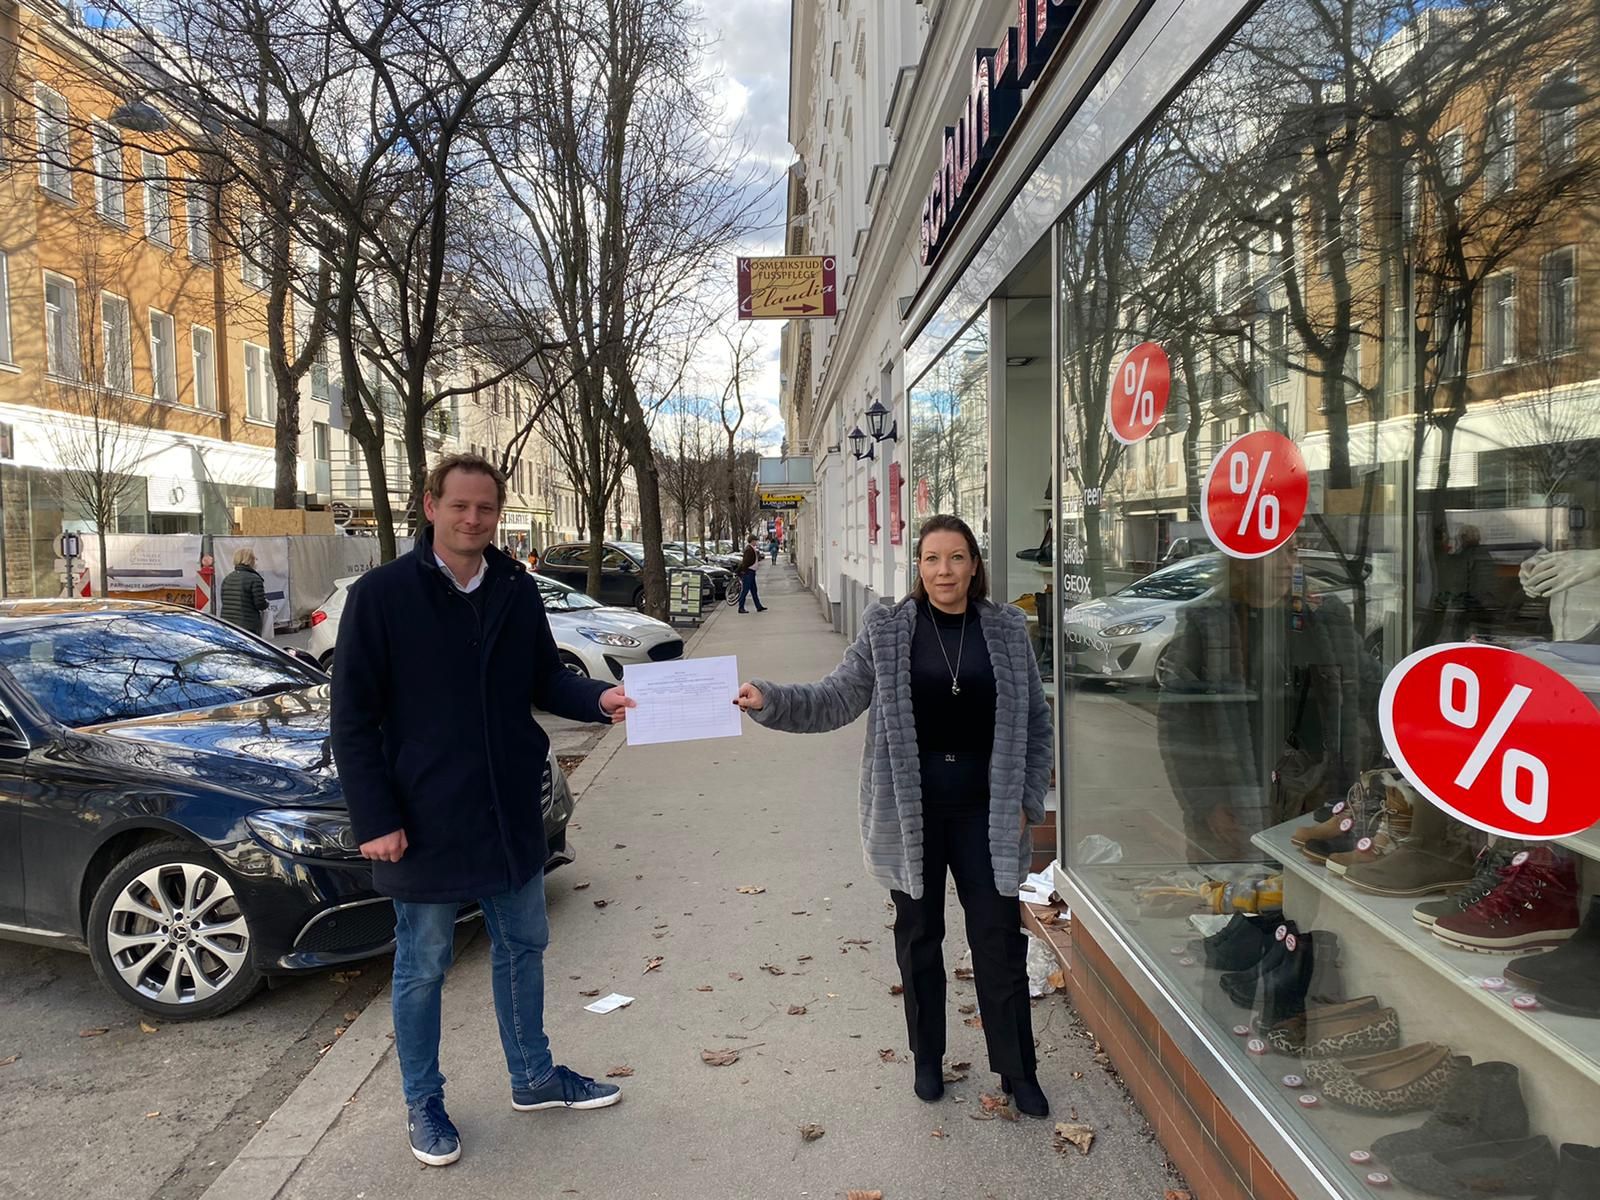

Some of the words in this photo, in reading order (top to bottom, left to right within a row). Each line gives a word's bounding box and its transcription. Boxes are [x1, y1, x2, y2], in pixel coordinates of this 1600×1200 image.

[741, 258, 836, 272] KOSMETIKSTUDIO
[758, 270, 817, 280] FUSSPFLEGE
[740, 279, 834, 312] Claudia
[1124, 357, 1154, 427] %
[1229, 451, 1280, 540] %
[1064, 573, 1091, 594] GEOX
[1439, 662, 1549, 824] %
